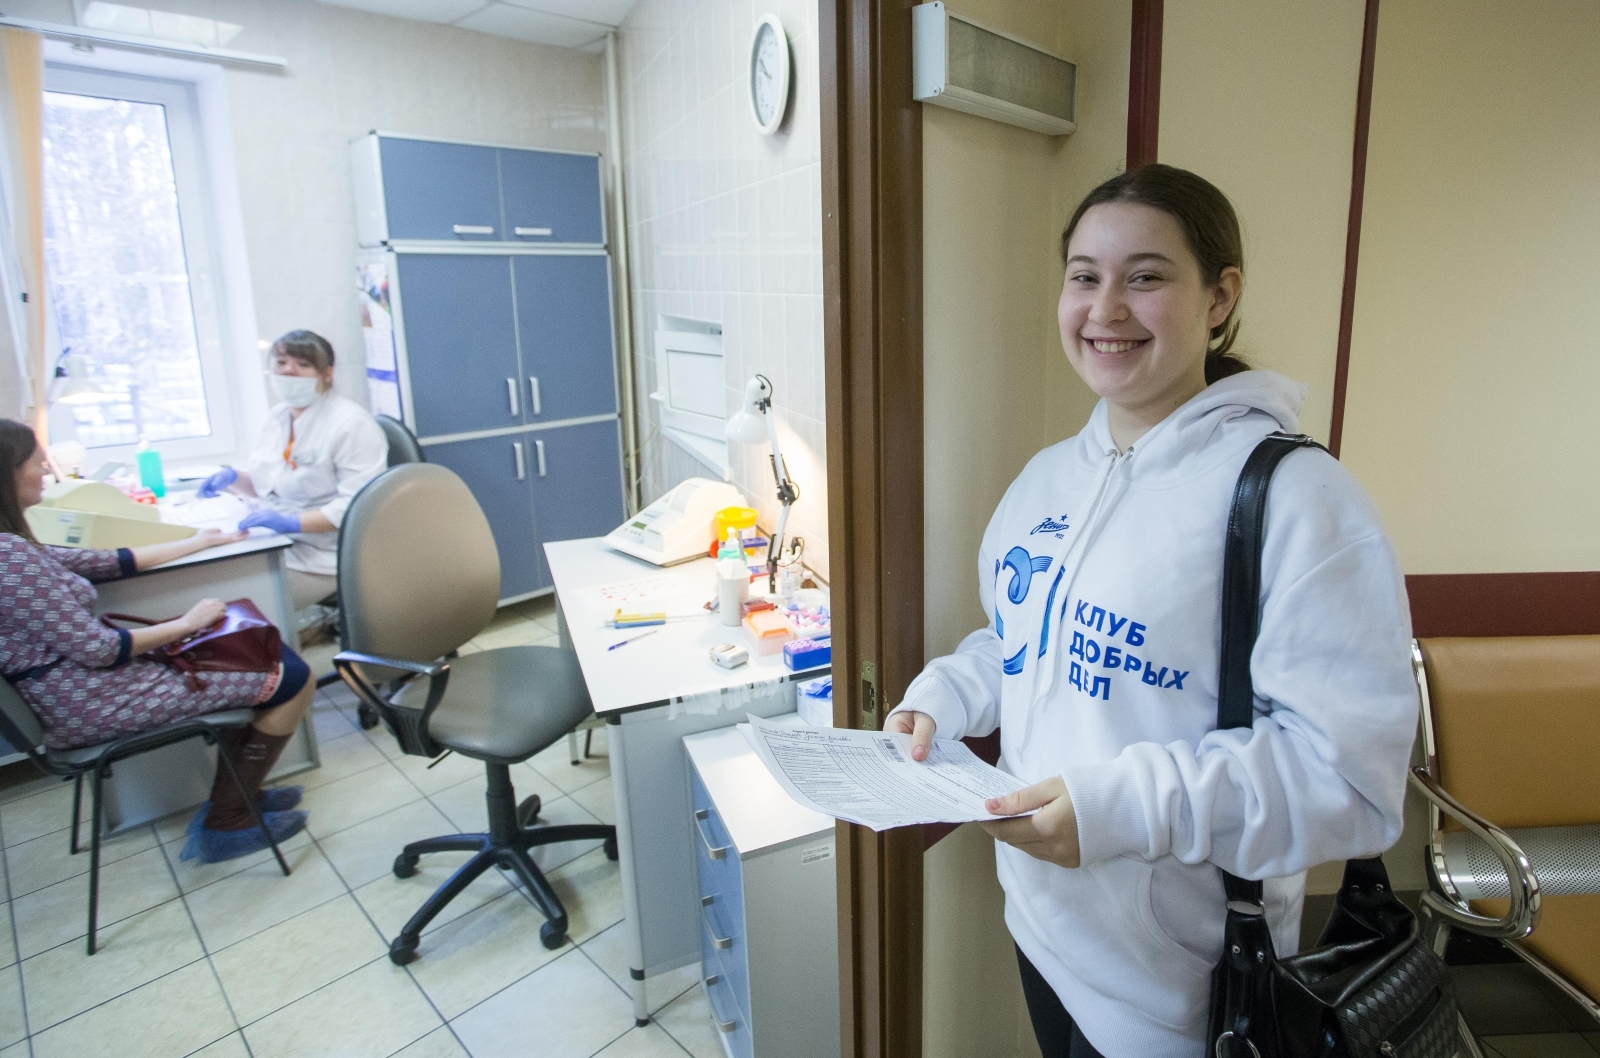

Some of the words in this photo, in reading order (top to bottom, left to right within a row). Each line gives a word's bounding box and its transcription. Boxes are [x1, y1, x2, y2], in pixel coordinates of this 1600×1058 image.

[1074, 600, 1147, 647] КЛУБ
[1068, 631, 1190, 691] ДОБРЫХ
[1068, 661, 1111, 701] ДЕЛ
